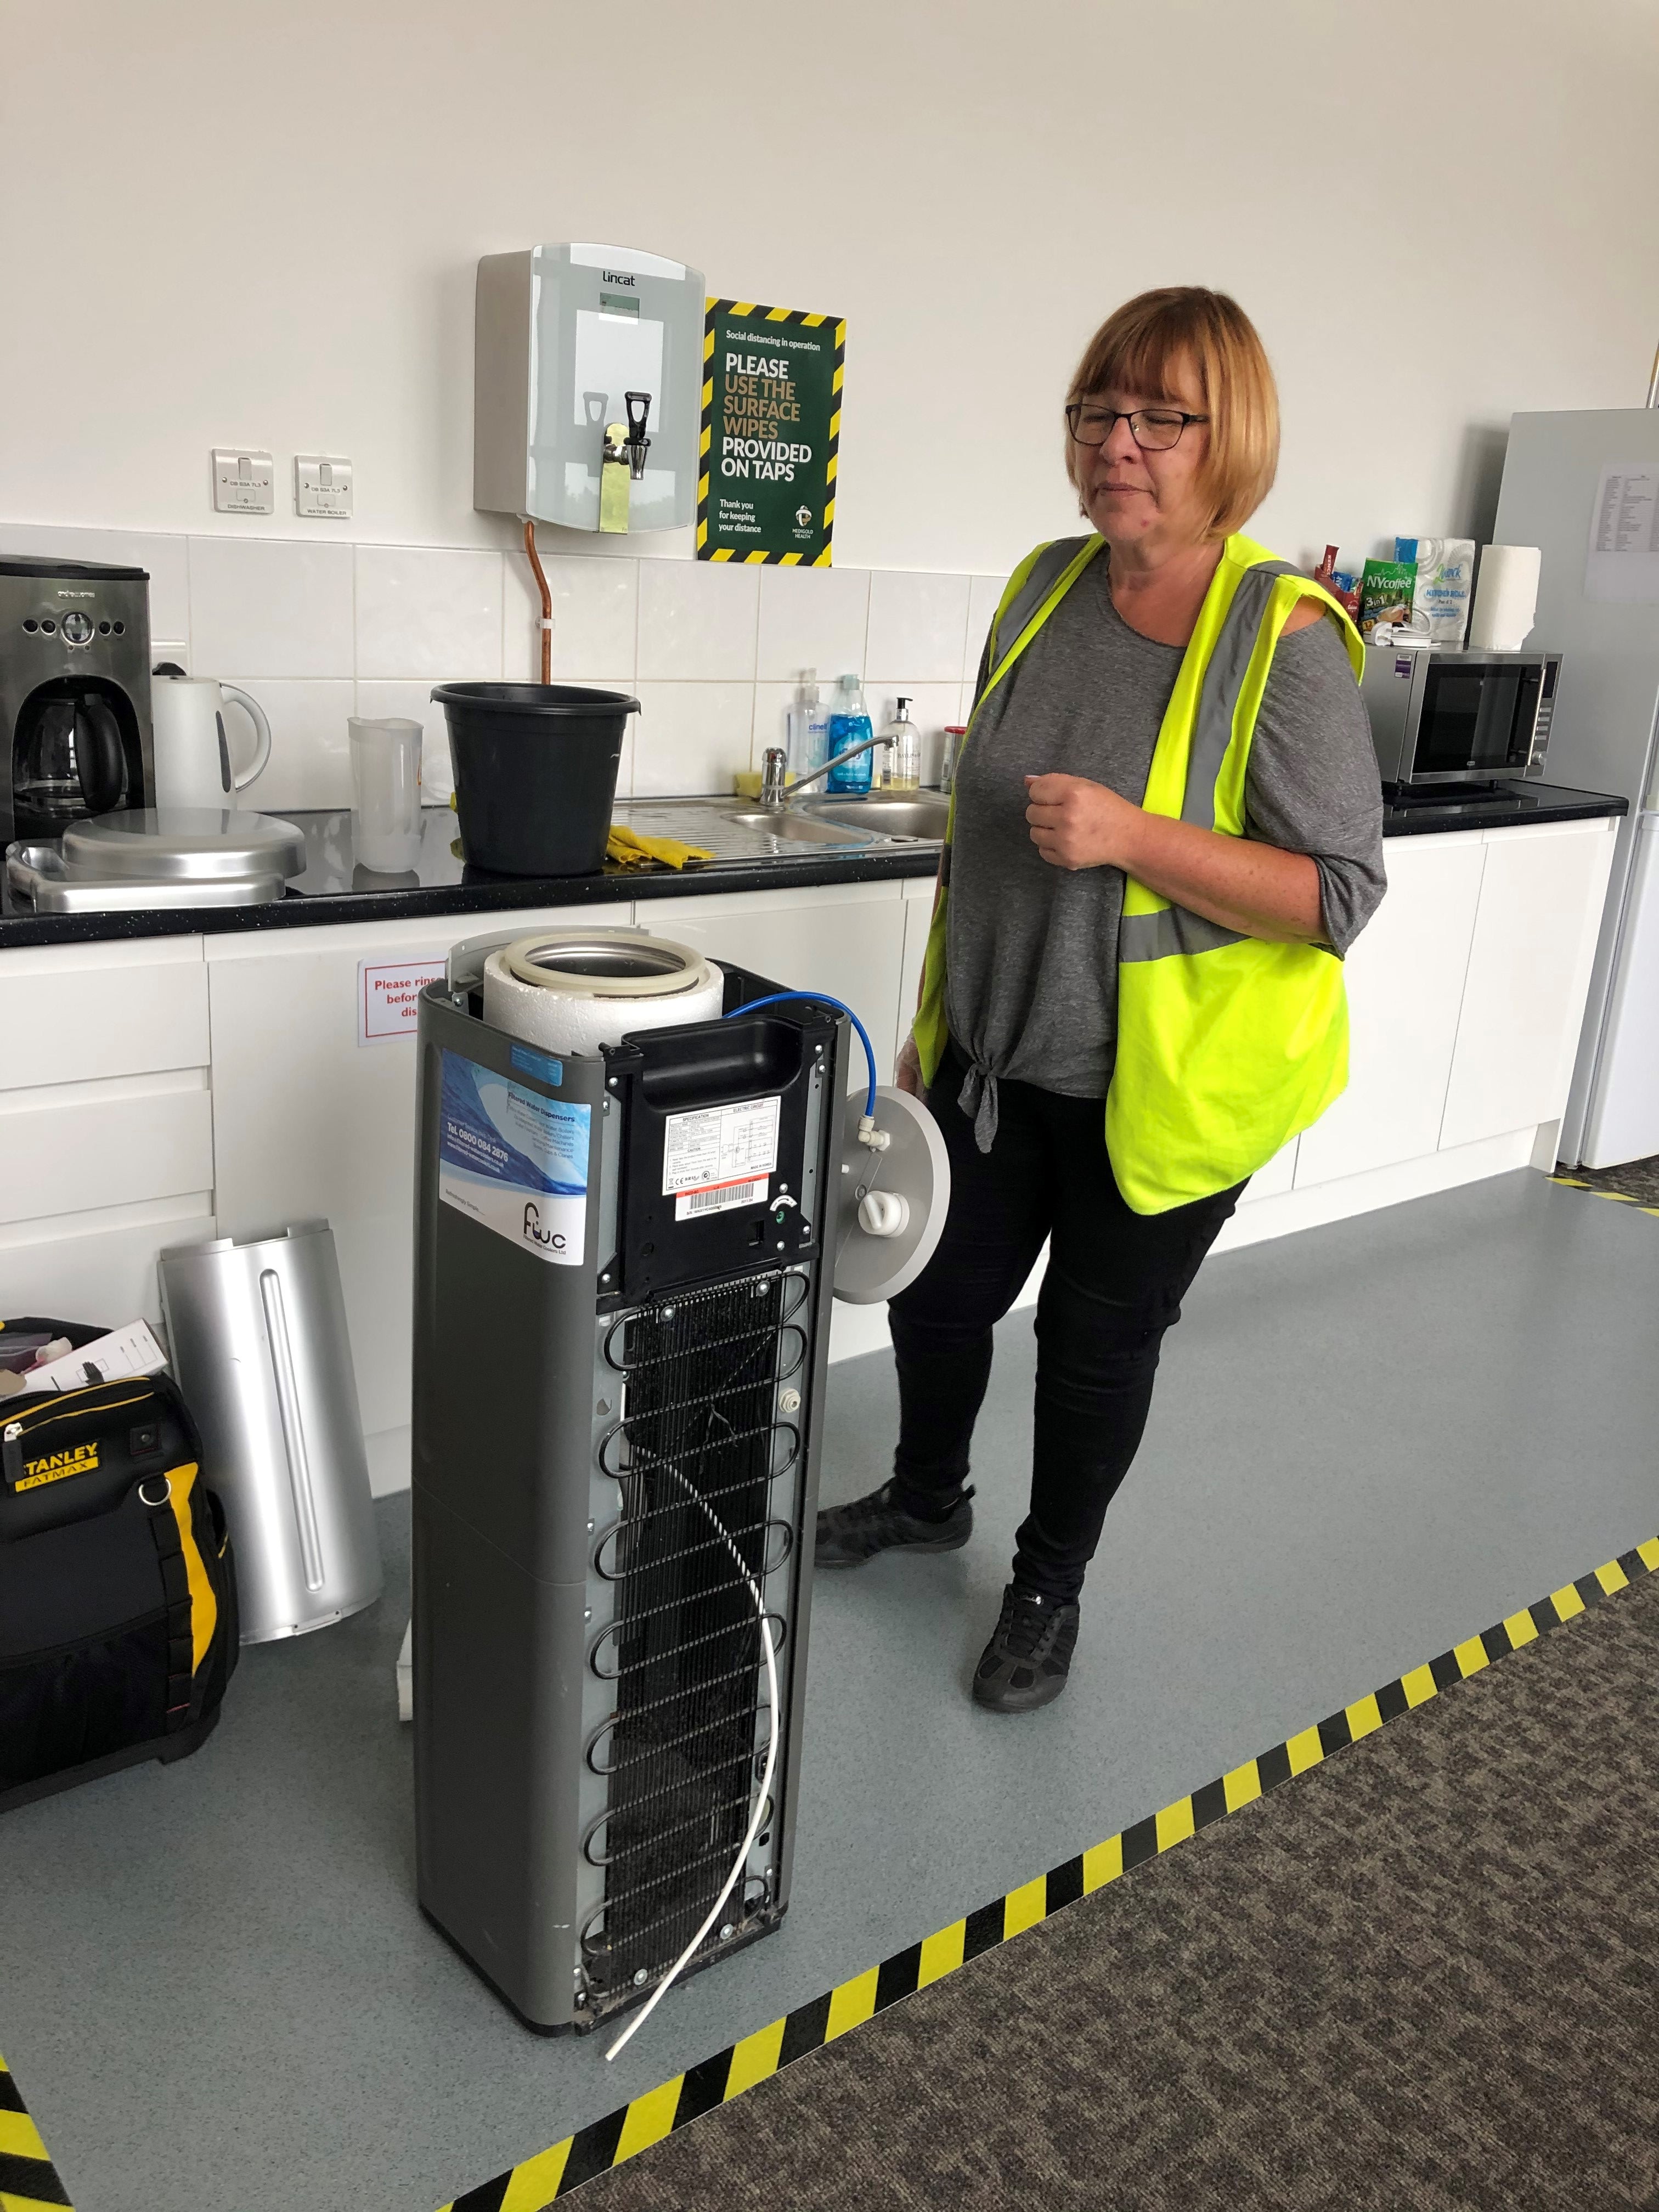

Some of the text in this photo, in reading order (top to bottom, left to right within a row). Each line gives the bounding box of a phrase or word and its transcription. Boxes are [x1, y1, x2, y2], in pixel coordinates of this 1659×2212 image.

[726, 330, 821, 351] Social distancing in operation
[725, 352, 789, 379] PLEASE
[725, 374, 796, 400] USE THE
[723, 395, 801, 422] SURFACE
[723, 415, 778, 439] WIPES
[722, 436, 812, 463] PROVIDED
[721, 457, 795, 482] ON TAPS
[719, 499, 754, 510] Thank you
[719, 510, 756, 522] for keeping
[718, 523, 761, 533] your distance
[1366, 575, 1412, 590] NYcoffee
[1365, 595, 1385, 607] 3in1
[375, 979, 411, 990] Please
[387, 992, 417, 1004] befor
[401, 1007, 417, 1017] dis
[508, 1092, 526, 1105] Filtered
[540, 1108, 575, 1122] Dispensers
[682, 1114, 709, 1122] SPECIFICATION
[459, 1128, 477, 1145] 0800
[477, 1138, 491, 1153] 084
[492, 1146, 509, 1162] 2876
[23, 1442, 98, 1475] TANLEY
[24, 1460, 88, 1487] FATMAX
